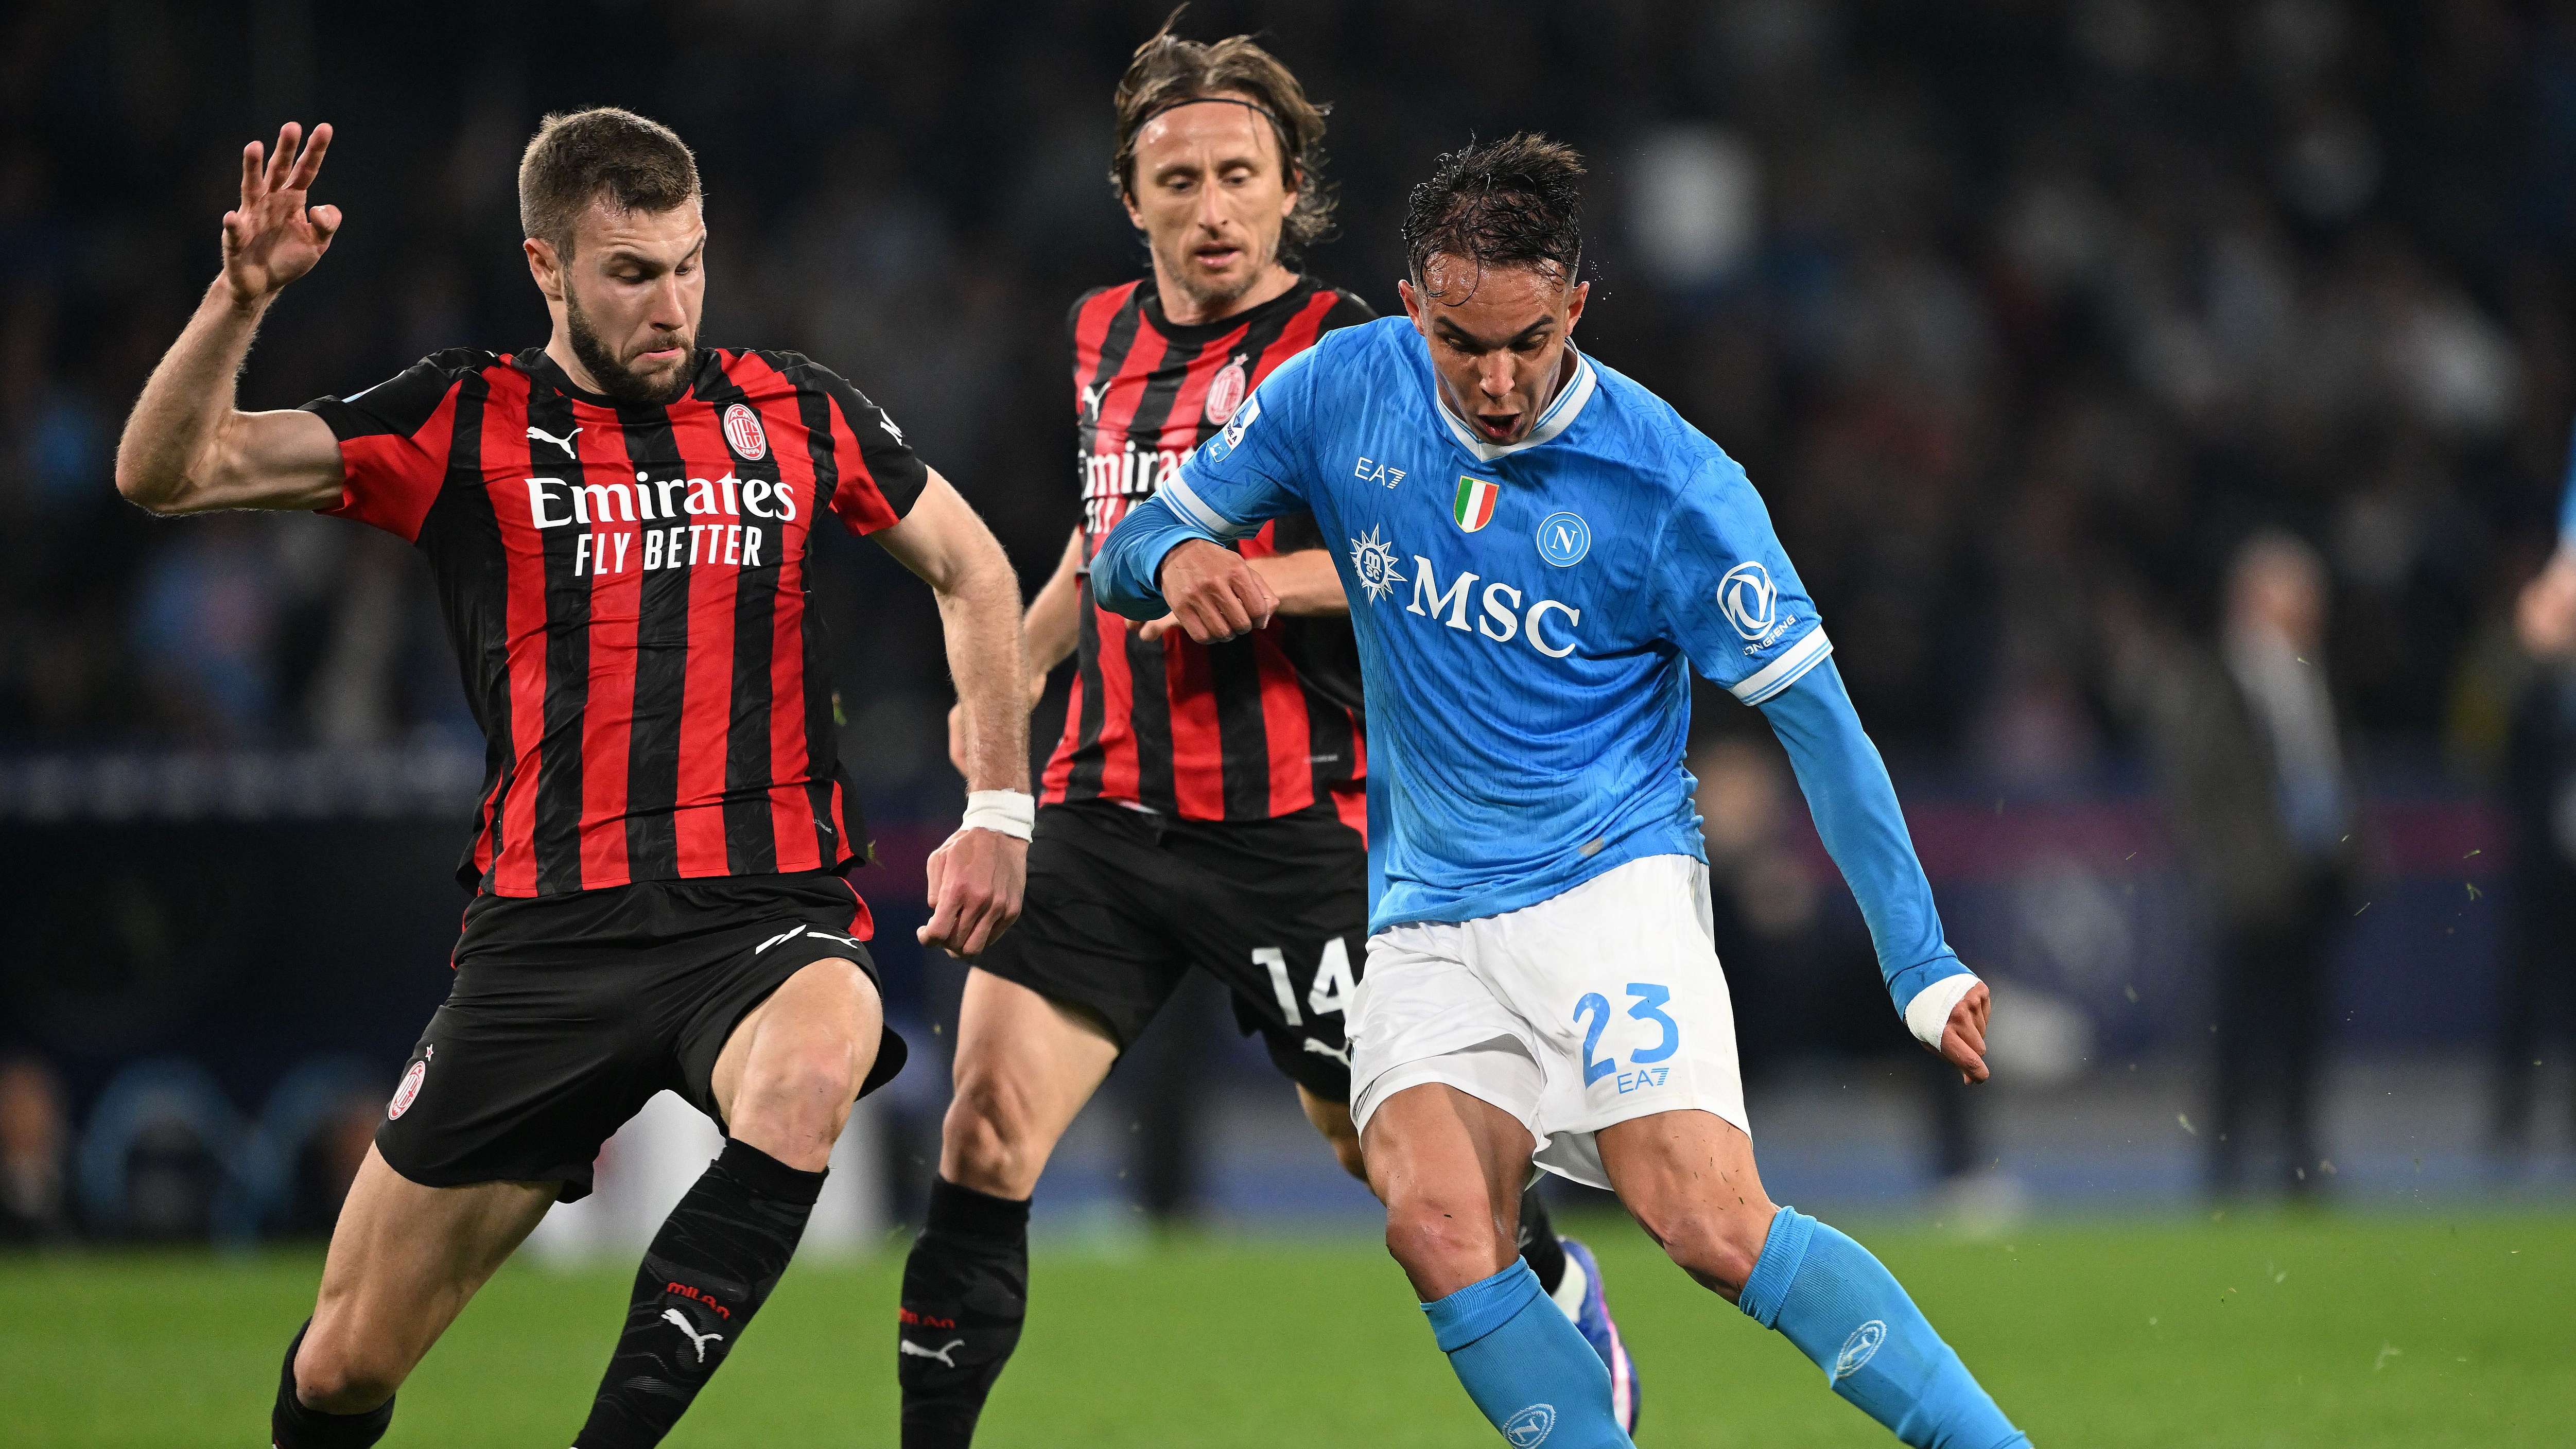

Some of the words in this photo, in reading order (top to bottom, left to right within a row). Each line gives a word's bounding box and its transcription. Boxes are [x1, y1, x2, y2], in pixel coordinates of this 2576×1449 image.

[730, 409, 752, 421] ACM
[1077, 440, 1196, 501] mira
[1354, 457, 1407, 490] EA7
[524, 471, 796, 529] Emirates
[575, 532, 632, 577] FLY
[643, 524, 762, 570] BETTER
[1550, 525, 1578, 554] N
[1406, 554, 1580, 658] MSC
[1251, 935, 1357, 1026] 14
[1573, 983, 1679, 1091] 23
[1617, 1067, 1670, 1094] EA7
